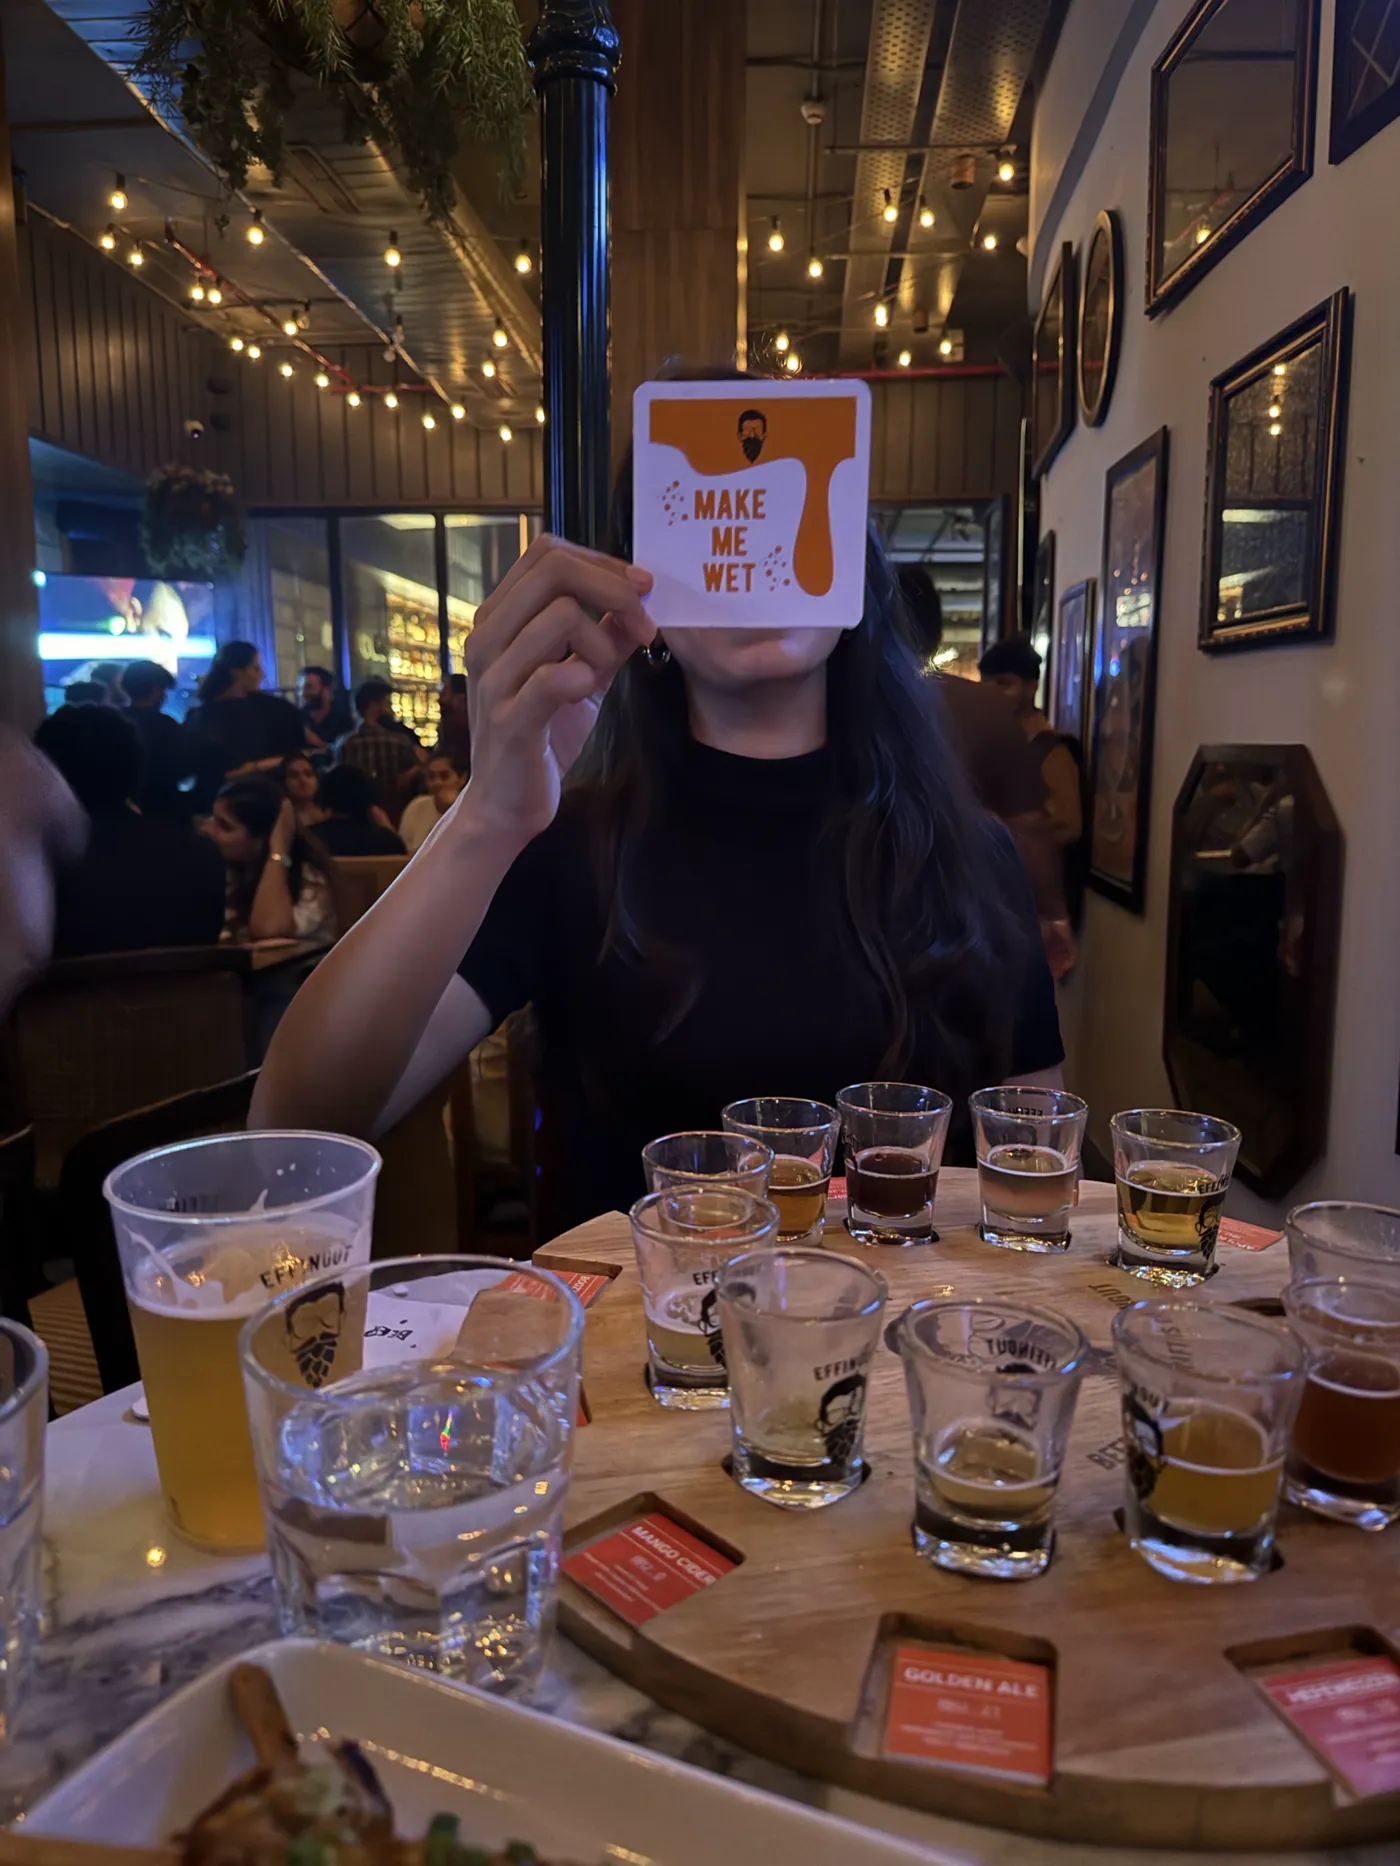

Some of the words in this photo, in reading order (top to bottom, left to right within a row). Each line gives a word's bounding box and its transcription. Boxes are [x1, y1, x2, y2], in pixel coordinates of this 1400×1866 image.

[694, 488, 767, 521] MAKE
[711, 526, 748, 557] ME
[702, 562, 756, 593] WET
[631, 1525, 680, 1559] MANGO
[676, 1556, 717, 1587] CIDER
[904, 1666, 994, 1692] GOLDEN
[997, 1680, 1039, 1698] ALE
